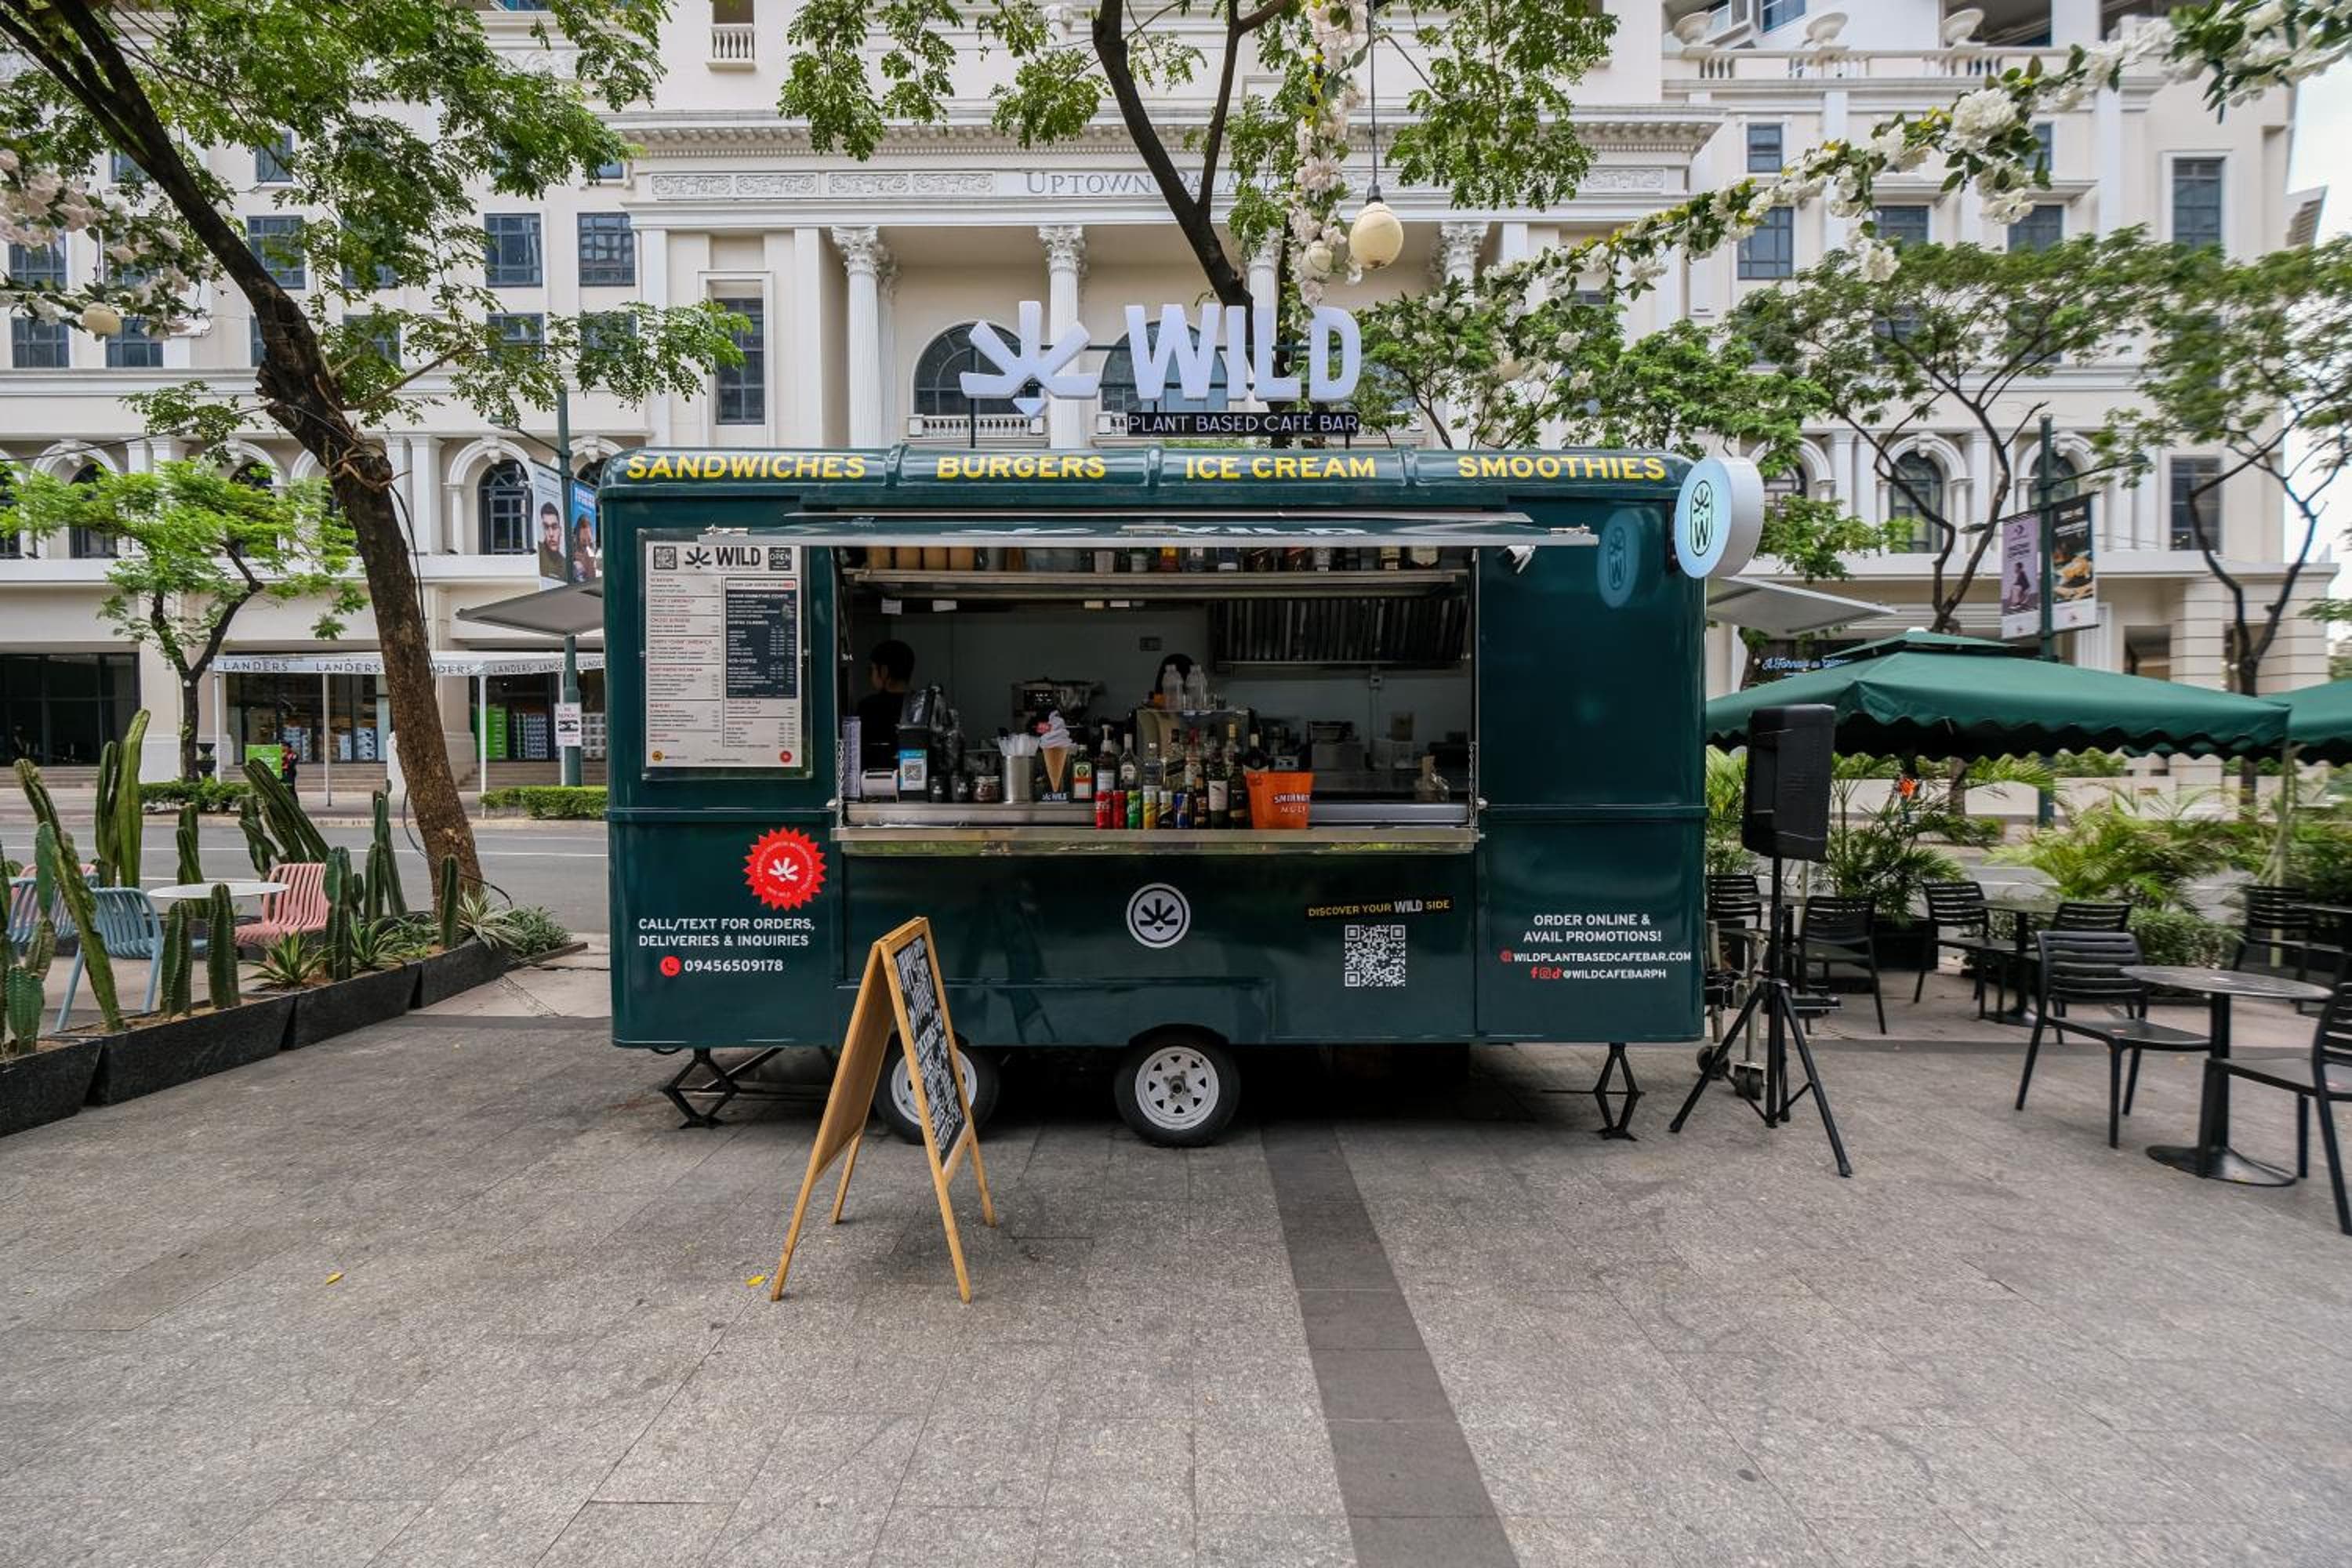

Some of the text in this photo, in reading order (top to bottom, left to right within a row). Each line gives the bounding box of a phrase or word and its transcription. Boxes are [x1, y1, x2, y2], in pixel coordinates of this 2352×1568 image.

[1025, 172, 1152, 194] UPTOWN
[1125, 303, 1361, 402] WILD
[1128, 415, 1359, 433] PLANT BASED CAFE BAR
[626, 456, 1668, 481] SANDWICHES BURGERS ICE CREAM SMOOTHIES
[1695, 517, 1709, 550] W
[716, 546, 761, 566] WILD
[223, 662, 289, 672] LANDERS
[316, 662, 381, 673] LANDERS
[493, 662, 532, 673] LANDERS
[539, 660, 564, 671] LANDE
[1308, 899, 1450, 916] DISCOVER YOUR WILD SIDE
[638, 918, 815, 931] CALL/TEXT FOR ORDERS,
[1534, 913, 1651, 926] ORDER ONLINE &
[638, 935, 809, 947] DELIVERIES & INQUIRIES
[1523, 931, 1662, 942] AVAIL PROMOTIONS!
[1514, 952, 1691, 963] WILDPLANTBASEDCAFEBAR.COM
[684, 960, 783, 972] 09456509178
[1563, 969, 1667, 979] @WILDCAFEBARPH
